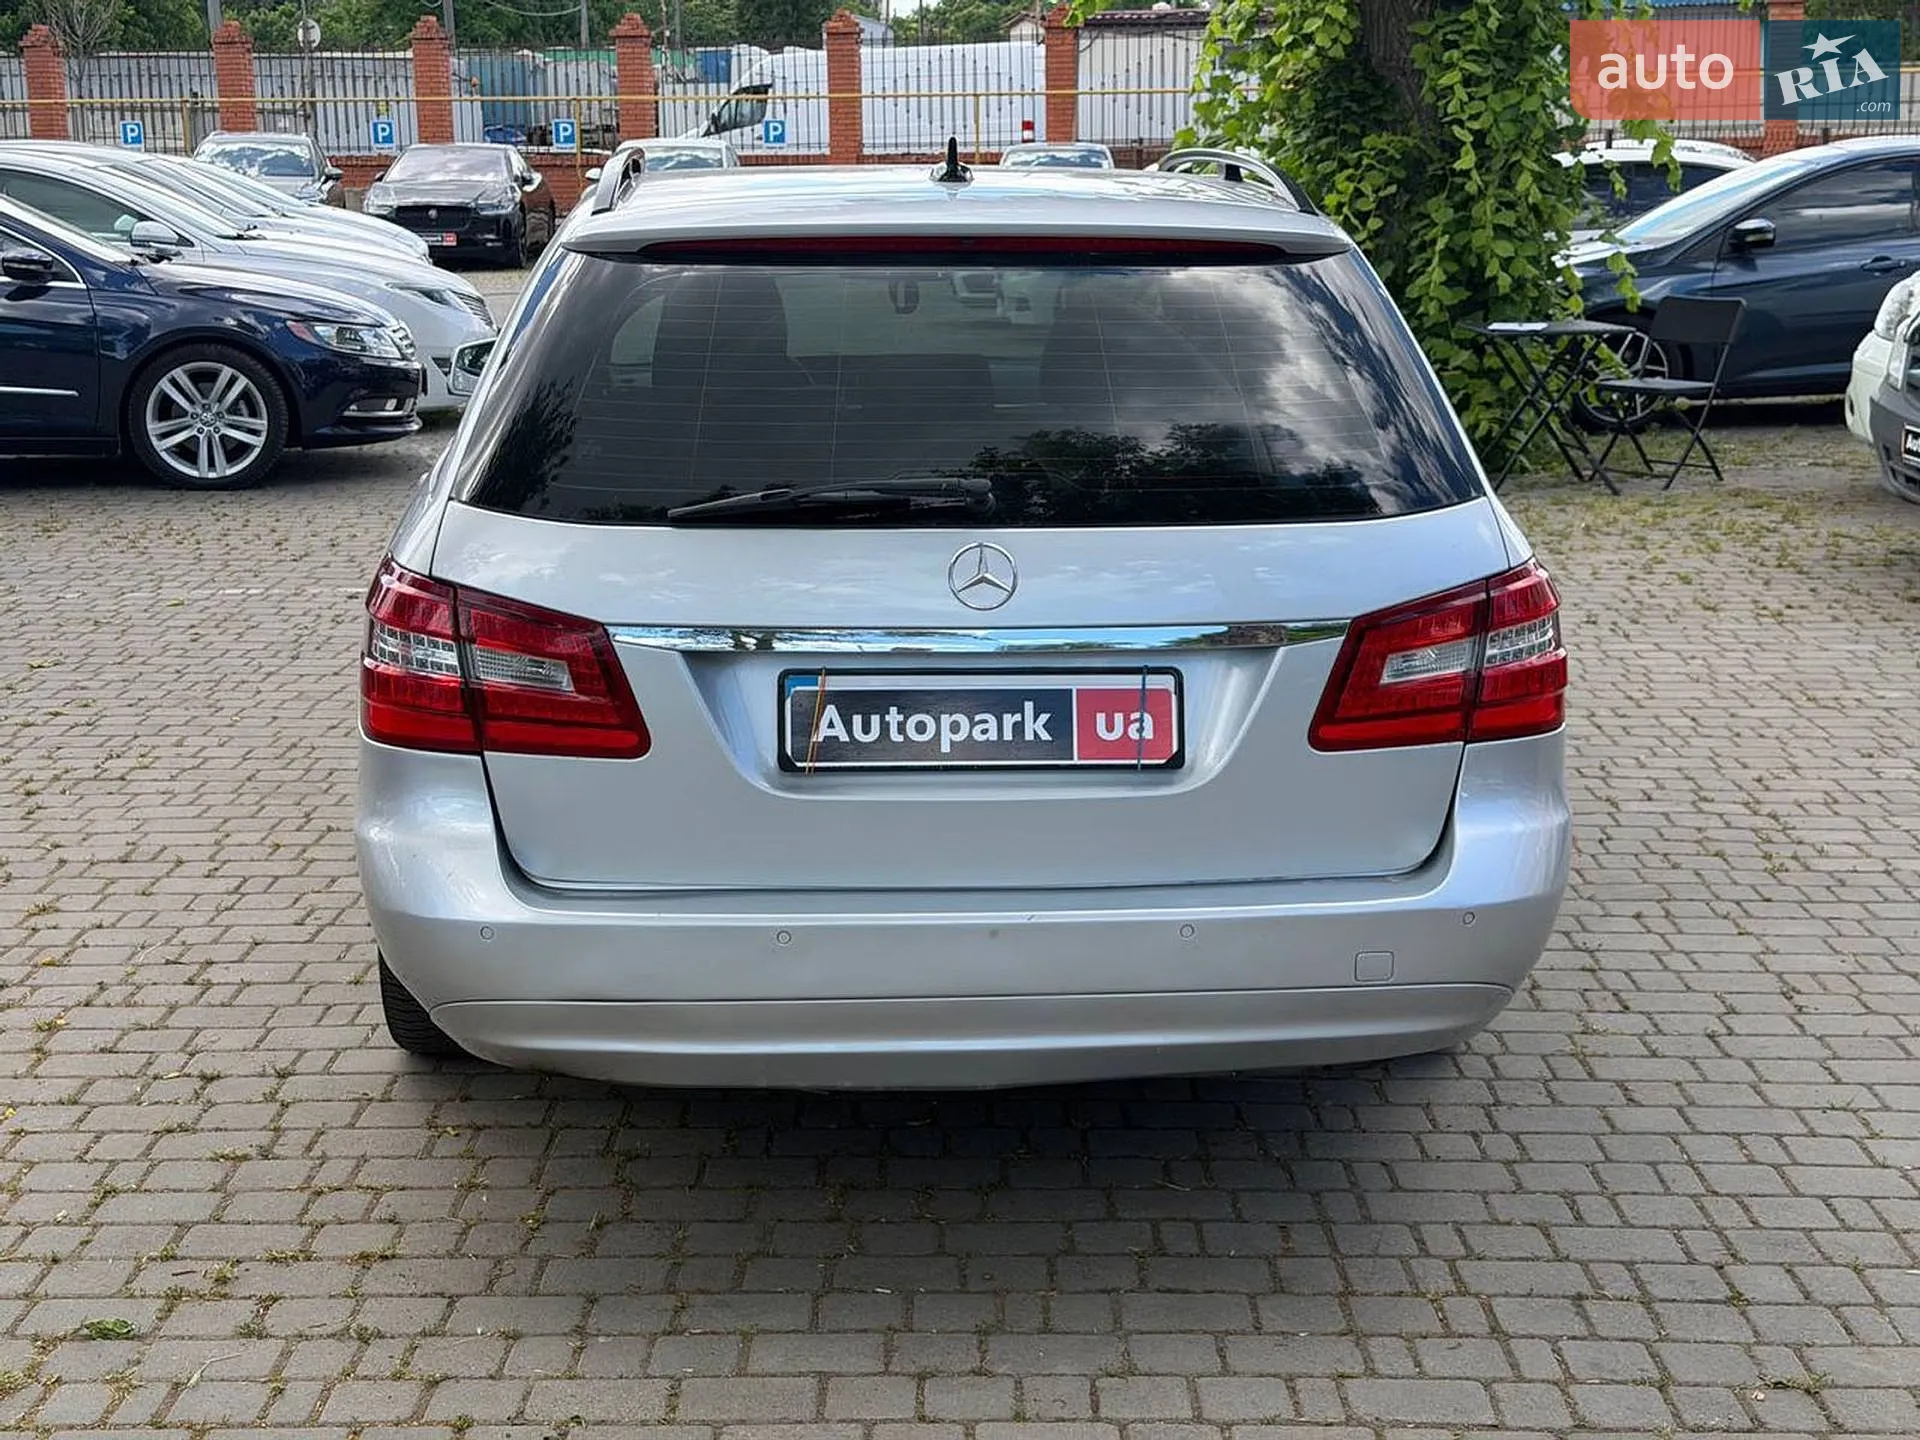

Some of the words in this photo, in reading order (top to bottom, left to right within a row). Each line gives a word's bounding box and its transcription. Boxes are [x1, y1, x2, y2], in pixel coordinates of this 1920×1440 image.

[126, 124, 139, 143] P
[377, 123, 390, 143] P
[559, 123, 572, 142] P
[769, 122, 782, 141] P
[814, 701, 1053, 753] Autopark
[1096, 711, 1154, 740] ua
